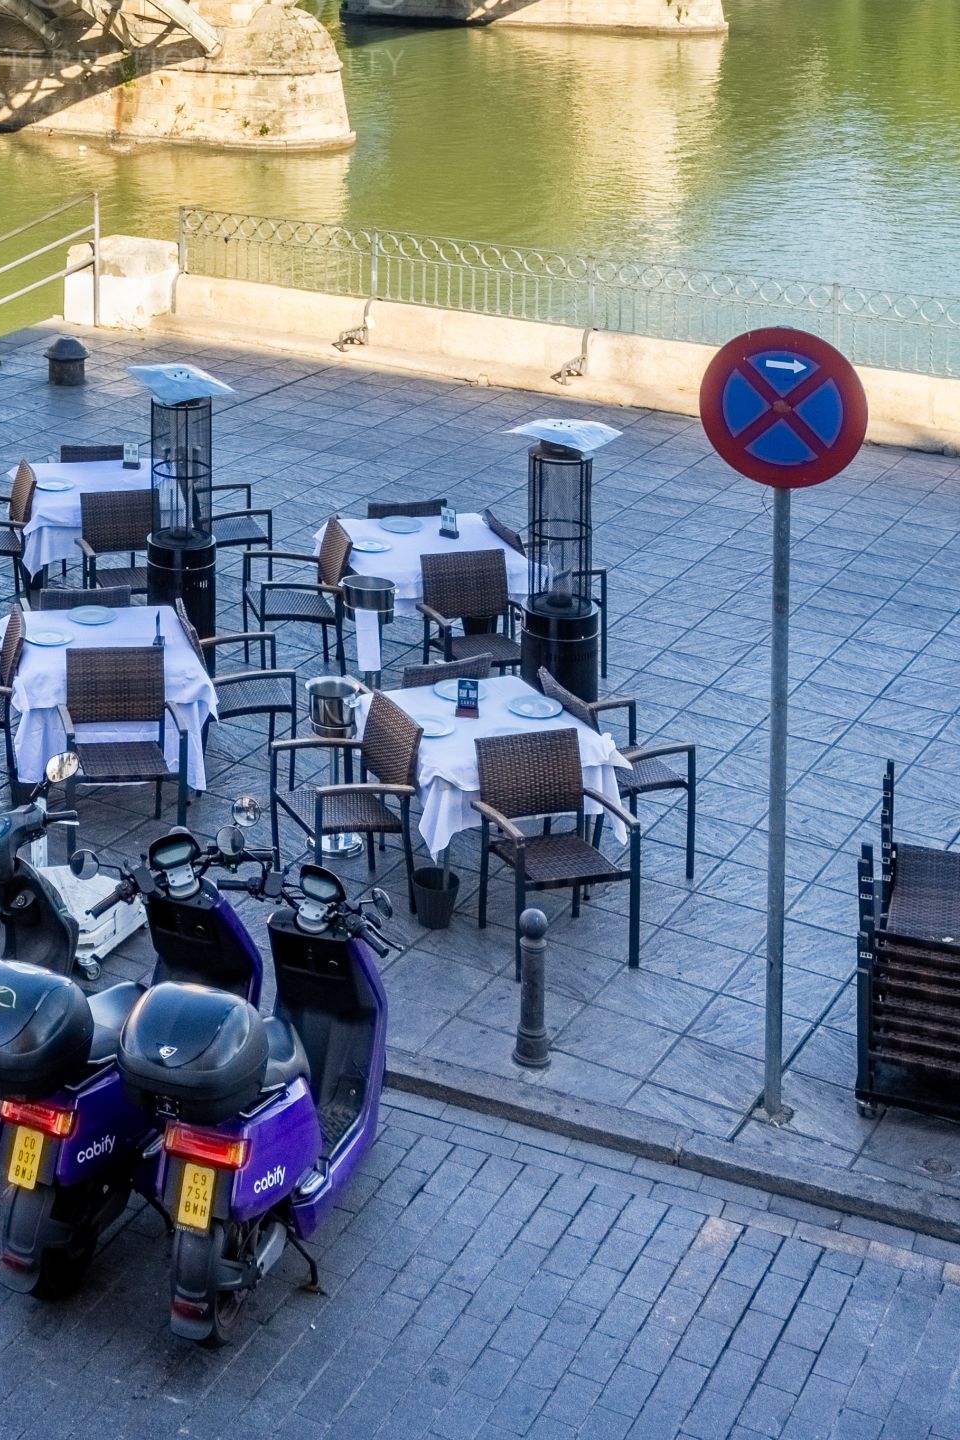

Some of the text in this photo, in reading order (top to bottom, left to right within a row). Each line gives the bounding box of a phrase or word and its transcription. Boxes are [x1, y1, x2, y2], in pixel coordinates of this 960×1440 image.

[17, 1149, 36, 1165] 037
[76, 1133, 117, 1164] cabify
[14, 1165, 33, 1182] BWJ
[192, 1171, 207, 1186] C9
[253, 1164, 287, 1195] cabify
[187, 1186, 209, 1202] 754
[184, 1200, 207, 1217] BWH
